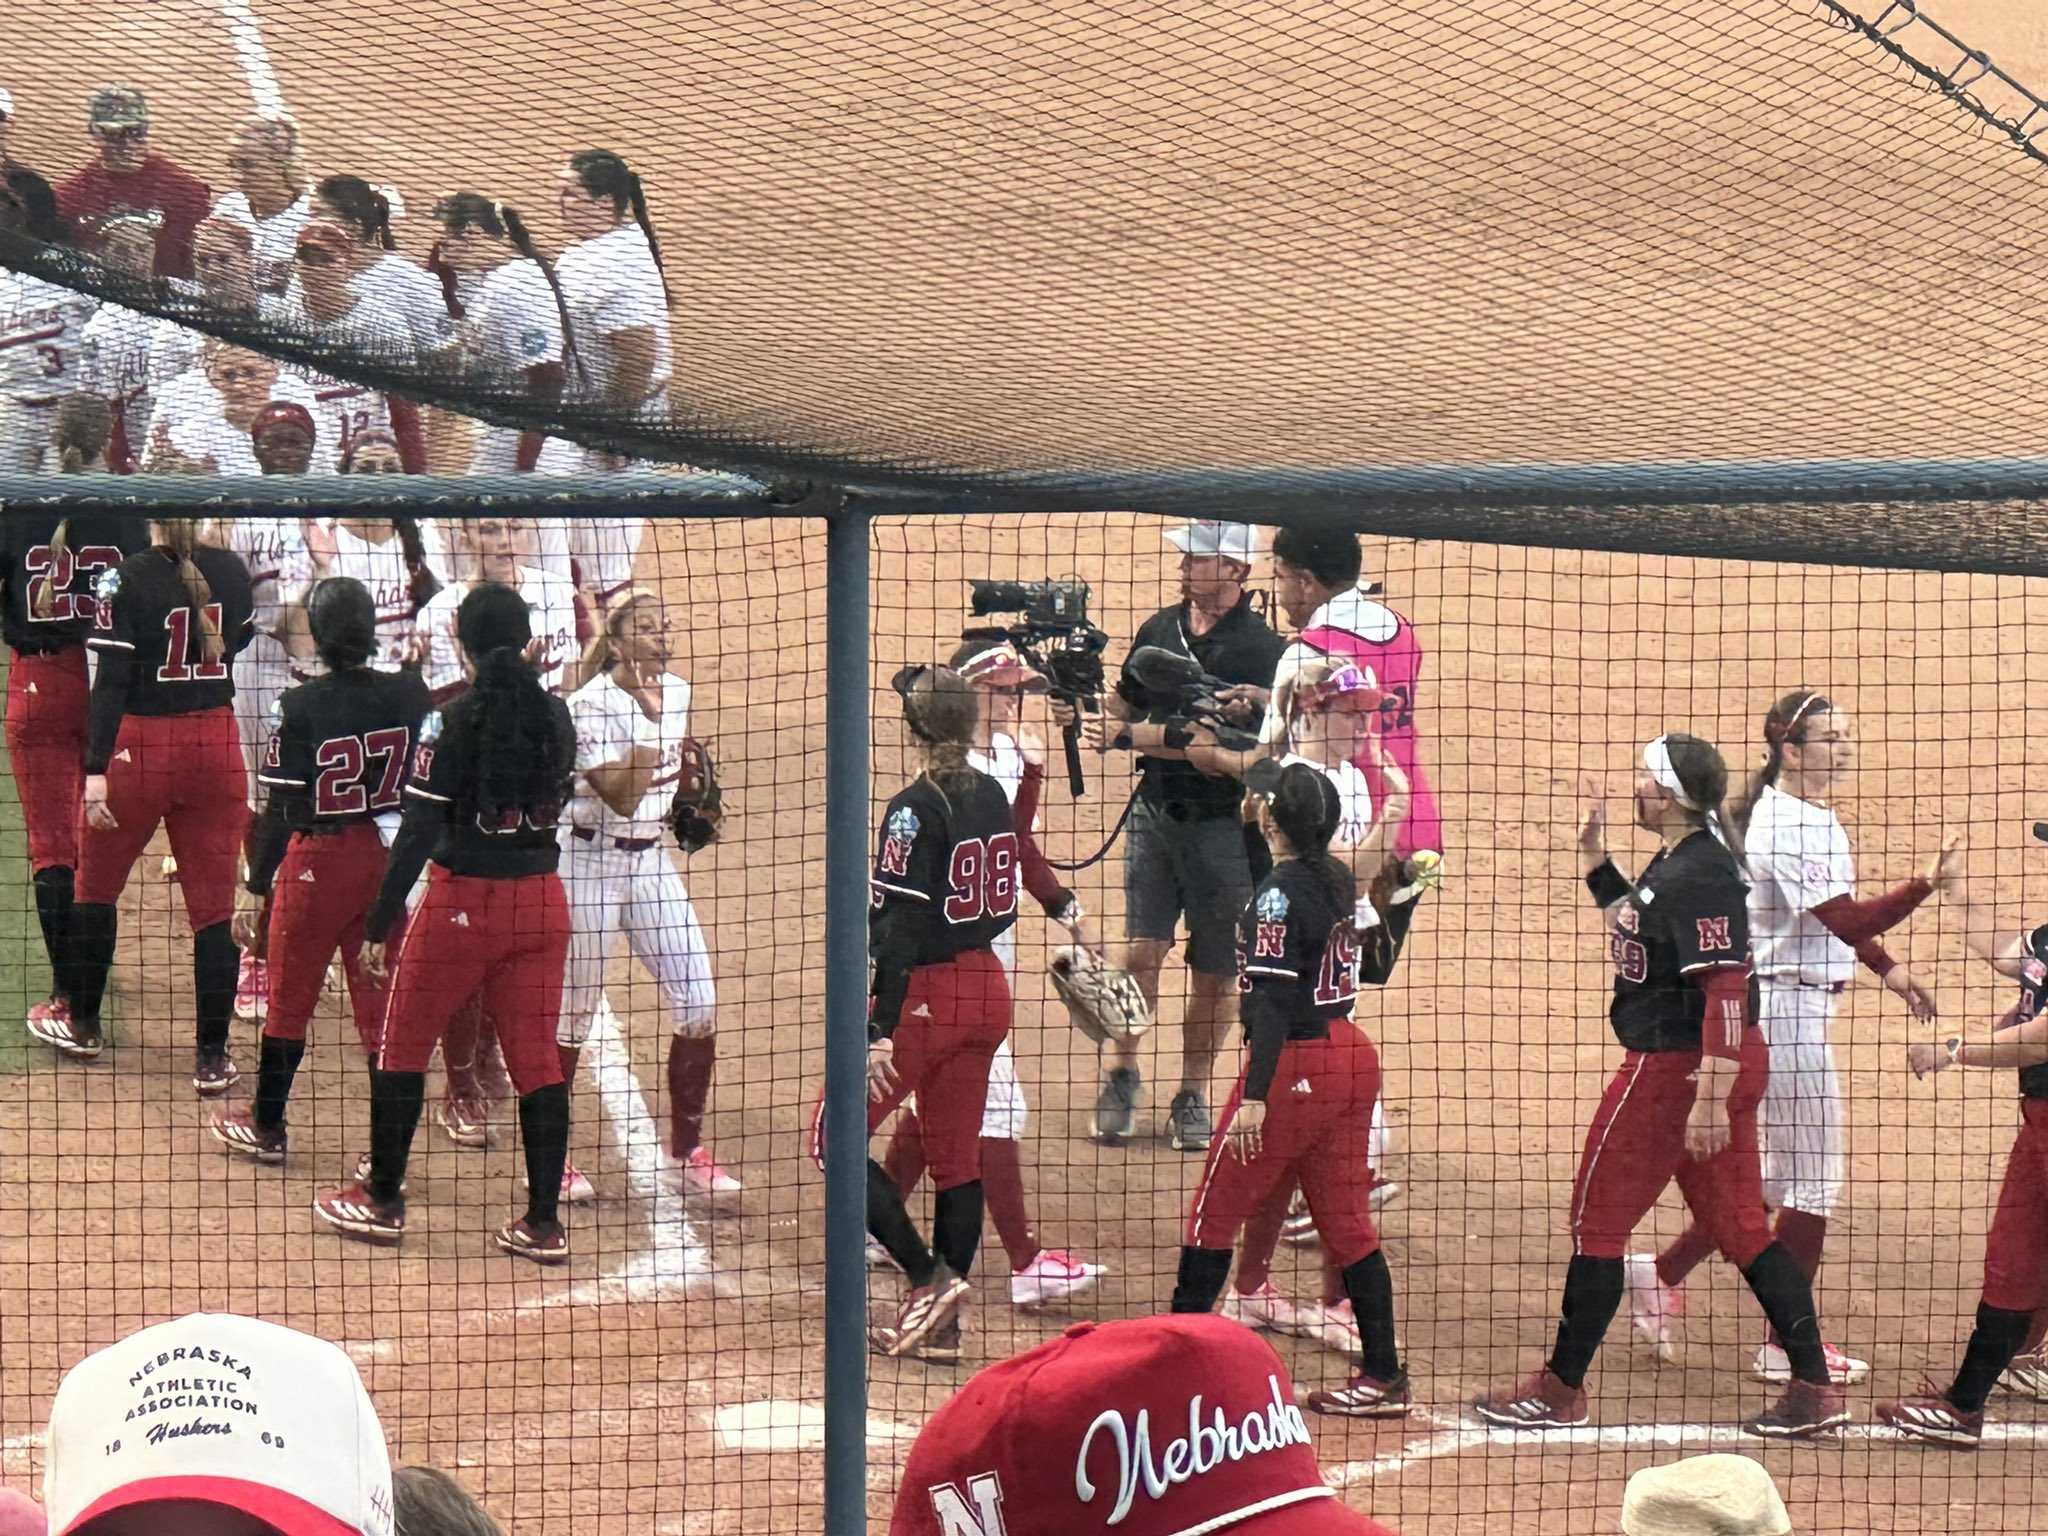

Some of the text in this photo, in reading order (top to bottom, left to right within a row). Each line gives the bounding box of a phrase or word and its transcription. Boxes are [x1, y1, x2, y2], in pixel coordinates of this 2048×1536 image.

[26, 545, 123, 622] 23
[156, 602, 228, 682] 11
[316, 726, 409, 815] 27
[881, 835, 912, 876] N
[944, 832, 1019, 924] 98
[1254, 922, 1287, 958] N
[1696, 916, 1732, 952] N
[129, 1346, 252, 1387] NEBRASKA
[125, 1395, 258, 1422] ASSOCIATION
[142, 1378, 238, 1398] ATHLETIC
[145, 1417, 232, 1446] Huskers
[1076, 1374, 1312, 1525] Nebraska
[928, 1469, 1008, 1536] N
